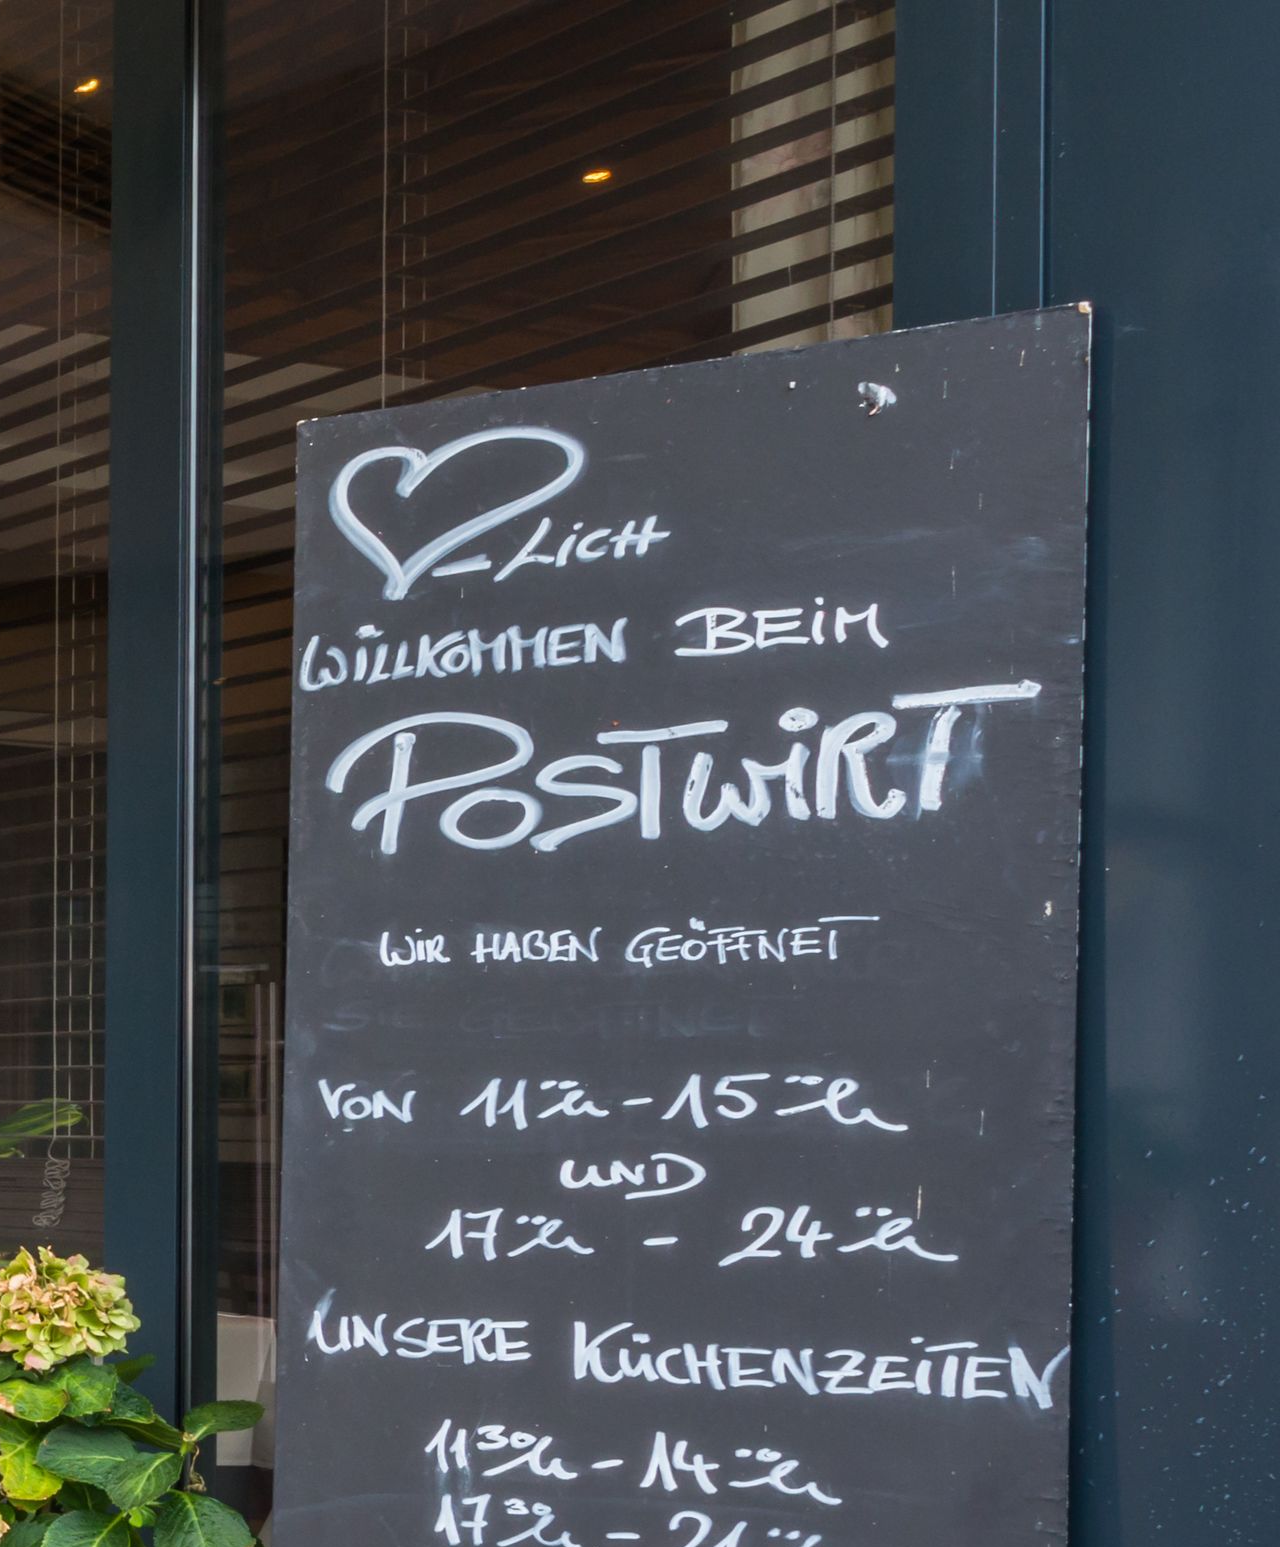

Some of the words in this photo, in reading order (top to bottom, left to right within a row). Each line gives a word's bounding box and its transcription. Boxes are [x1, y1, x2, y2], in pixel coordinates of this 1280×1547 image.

[298, 616, 627, 692] WILLKOMMEN
[674, 596, 889, 657] BEIM
[326, 677, 1042, 855] POSTWIRT
[379, 927, 451, 968] WIR
[470, 926, 603, 964] HABEN
[624, 915, 881, 968] GEÖFFNET
[317, 1077, 417, 1124] VON
[559, 1152, 708, 1200] UND
[306, 1290, 533, 1365] UNSERE
[573, 1320, 1071, 1410] KÜCHENZEITEN
